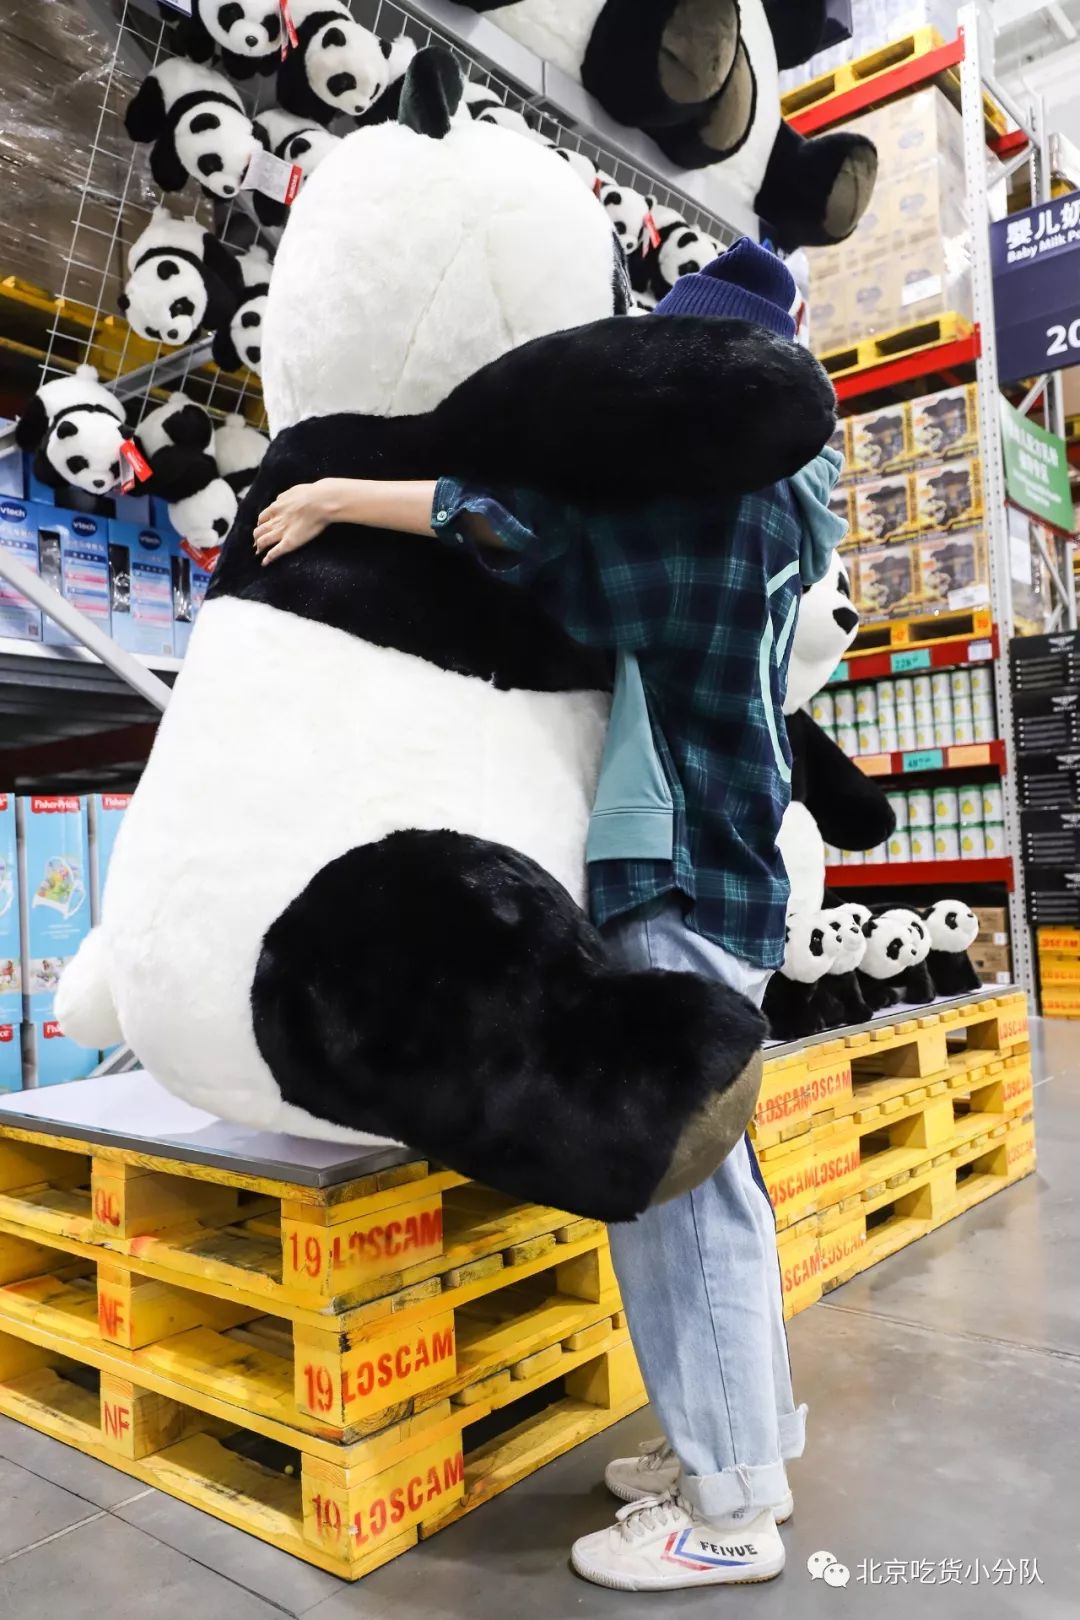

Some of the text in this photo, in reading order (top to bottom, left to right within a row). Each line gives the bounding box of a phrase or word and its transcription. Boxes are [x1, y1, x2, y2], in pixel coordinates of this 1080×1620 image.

[1007, 245, 1038, 264] Baby
[1039, 234, 1067, 252] Milk
[290, 1208, 442, 1278] 19 LOSCAM
[100, 1294, 124, 1337] NF
[304, 1327, 454, 1412] 19 LOSCAM
[104, 1401, 129, 1440] NF
[354, 1451, 464, 1546] LOSCAM
[700, 1540, 758, 1557] FEIYUE
